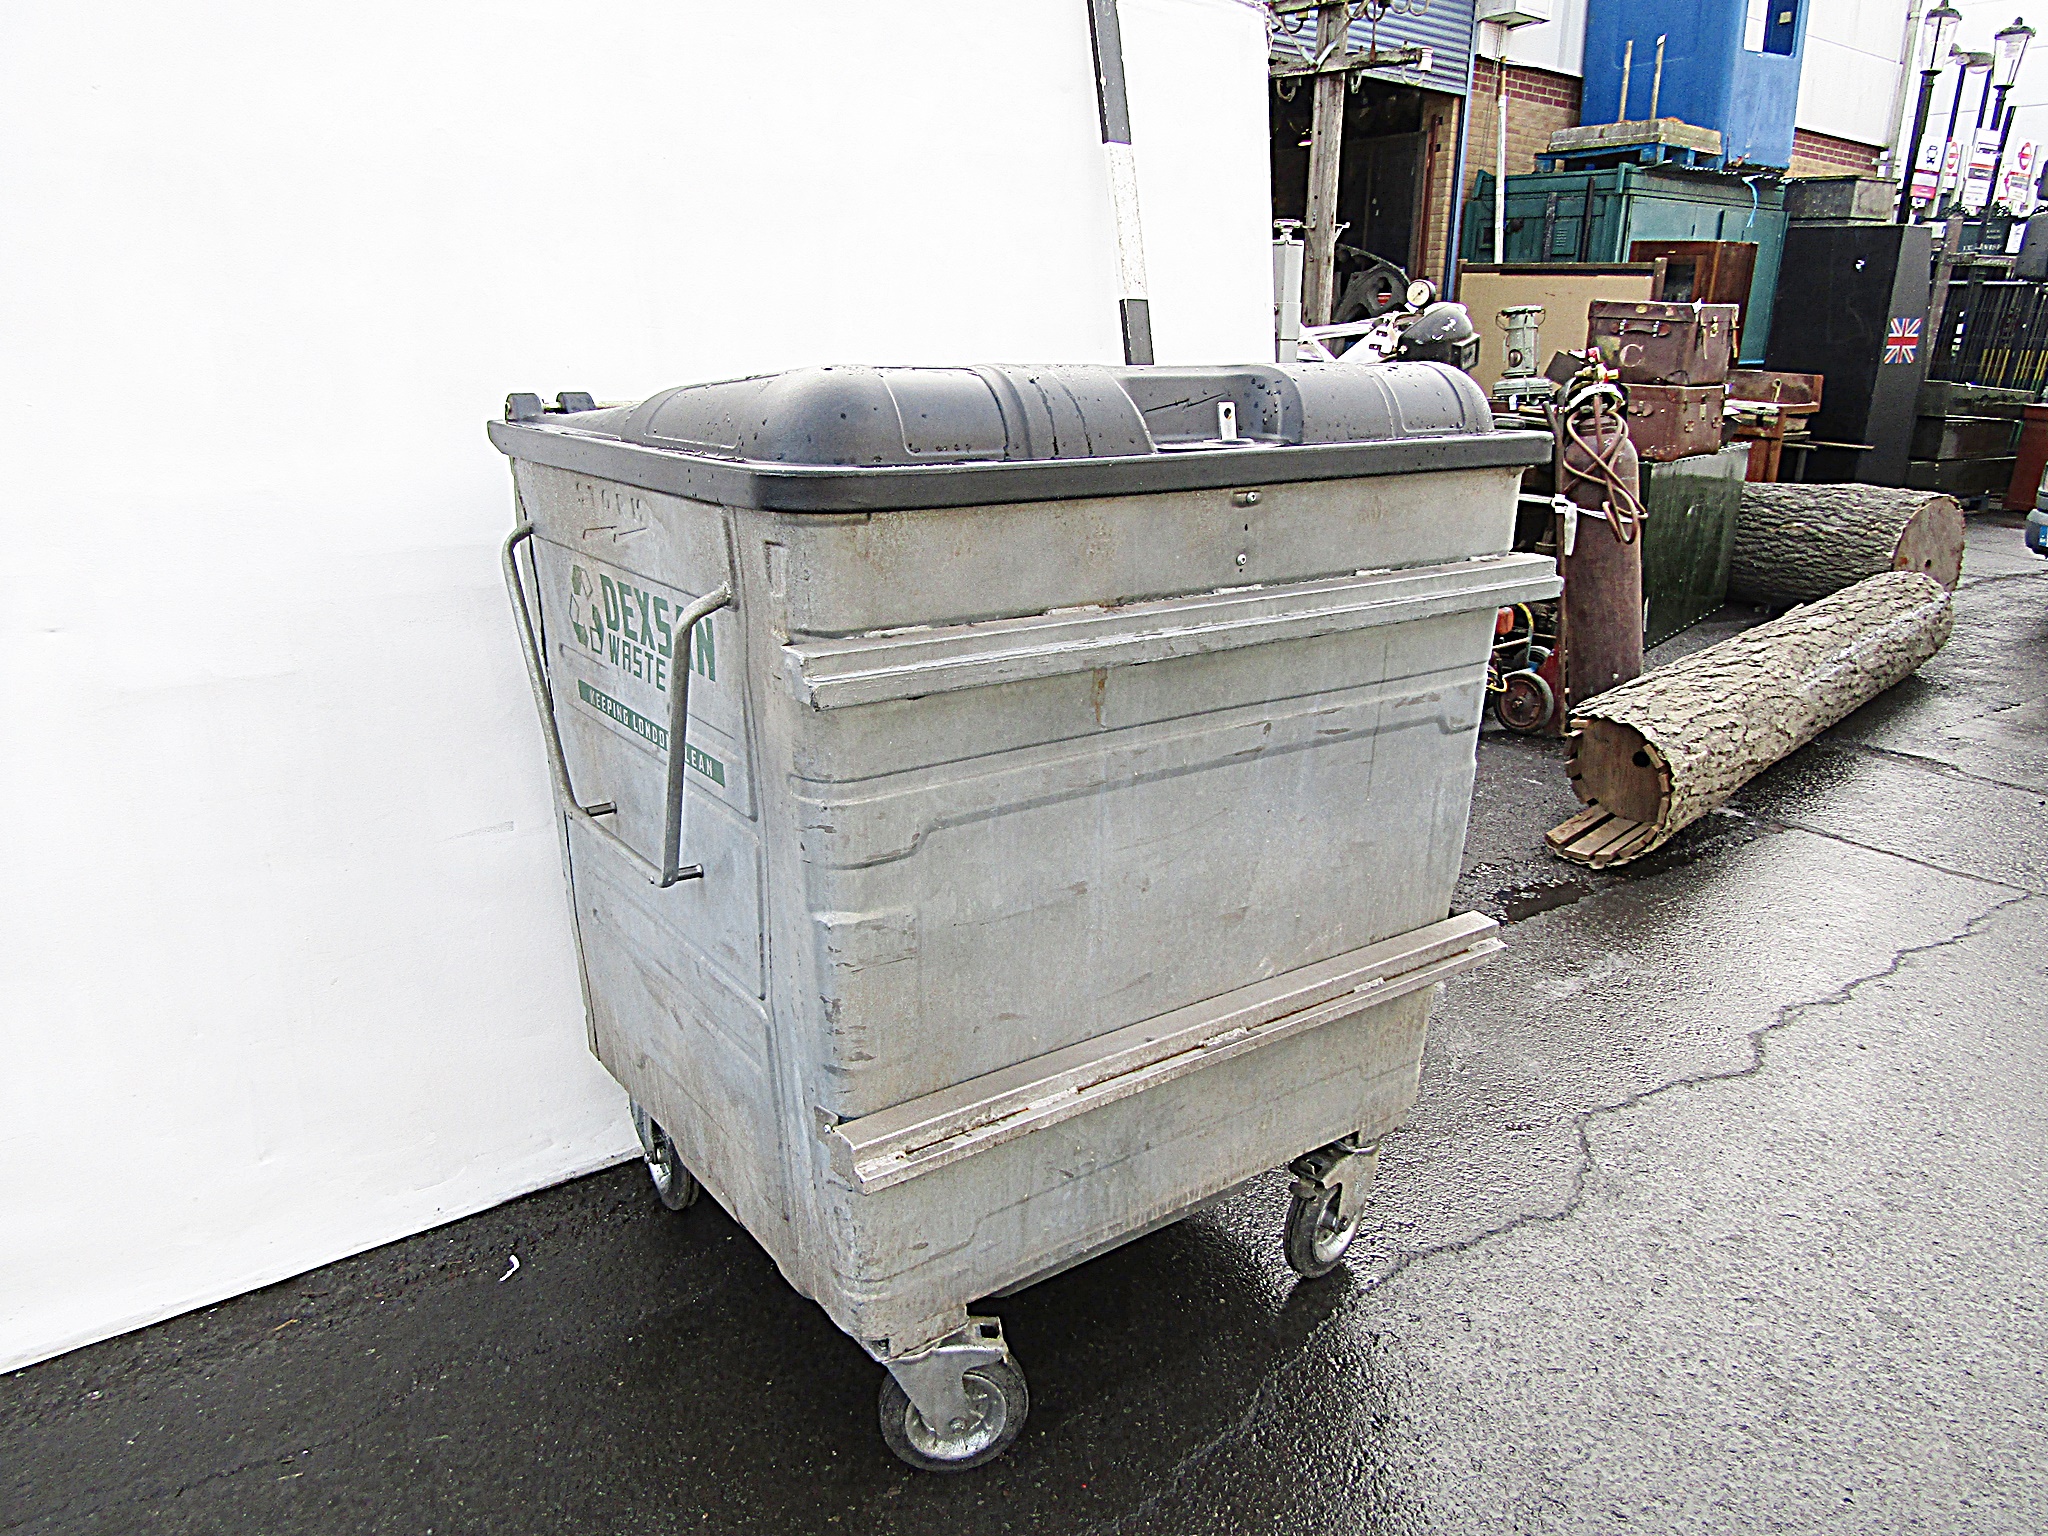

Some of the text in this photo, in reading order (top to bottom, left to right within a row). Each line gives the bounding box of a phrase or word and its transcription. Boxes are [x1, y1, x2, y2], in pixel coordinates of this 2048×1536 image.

[1619, 343, 1645, 368] C
[600, 573, 716, 682] DEXSN
[608, 633, 666, 692] WASTE
[589, 689, 629, 726] KEEPING
[684, 750, 713, 778] LEAN
